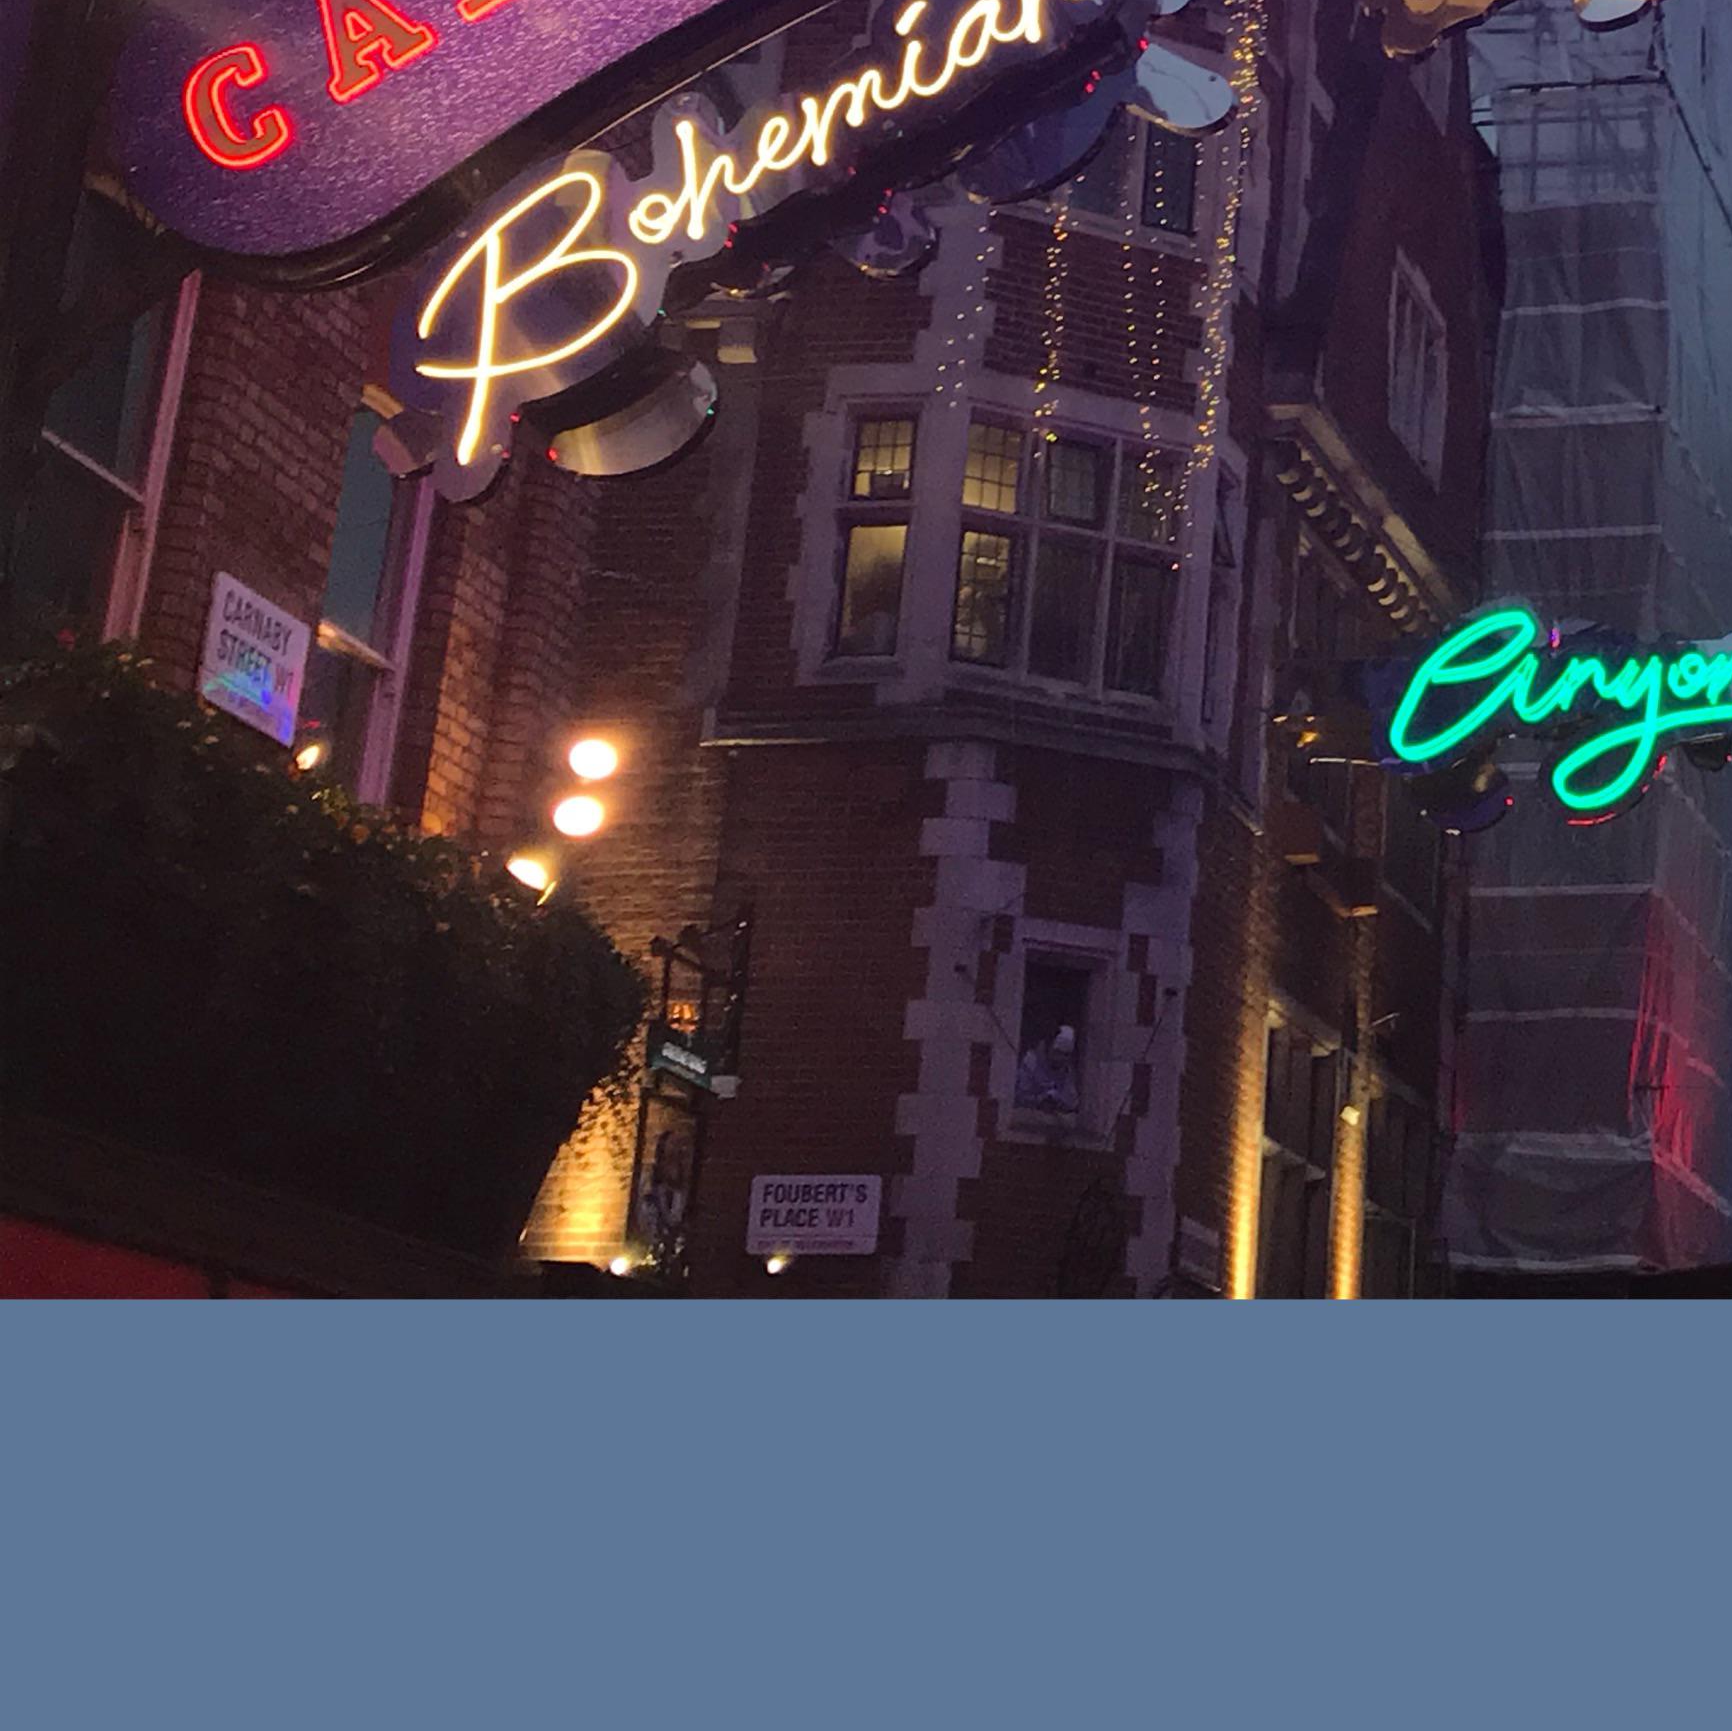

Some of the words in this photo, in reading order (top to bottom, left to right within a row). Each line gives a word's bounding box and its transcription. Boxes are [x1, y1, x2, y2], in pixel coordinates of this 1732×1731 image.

[222, 588, 293, 656] CARNABY
[762, 1183, 868, 1204] FOUBERT'S
[759, 1207, 820, 1228] PLACE
[825, 1207, 855, 1228] W1
